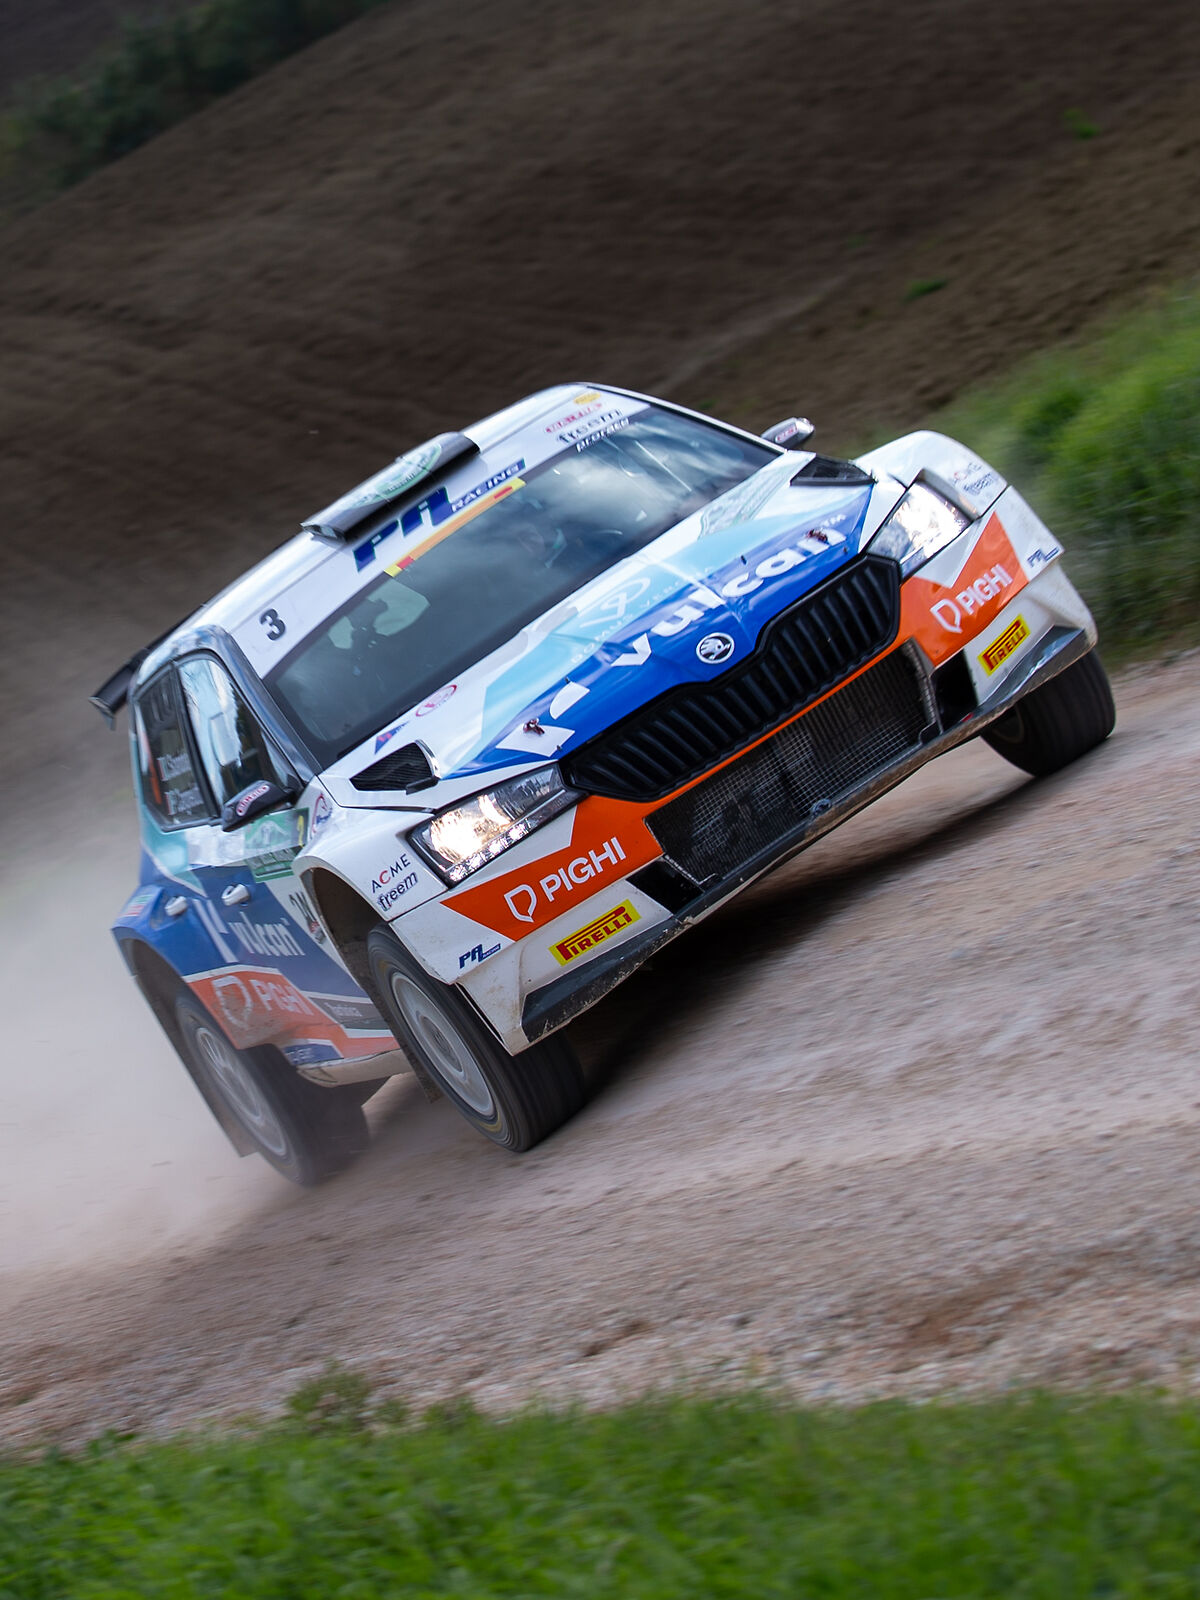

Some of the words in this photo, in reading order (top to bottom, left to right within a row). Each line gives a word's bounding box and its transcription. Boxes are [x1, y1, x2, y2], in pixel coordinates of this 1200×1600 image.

[451, 463, 520, 513] RACING
[610, 527, 847, 667] vulcan
[955, 563, 1013, 615] PIGHI
[260, 608, 286, 641] 3
[982, 619, 1027, 671] PIRELLI
[371, 853, 411, 893] ACME
[378, 871, 419, 911] freem
[539, 836, 627, 903] PIGHI
[555, 906, 632, 961] PIRELLI
